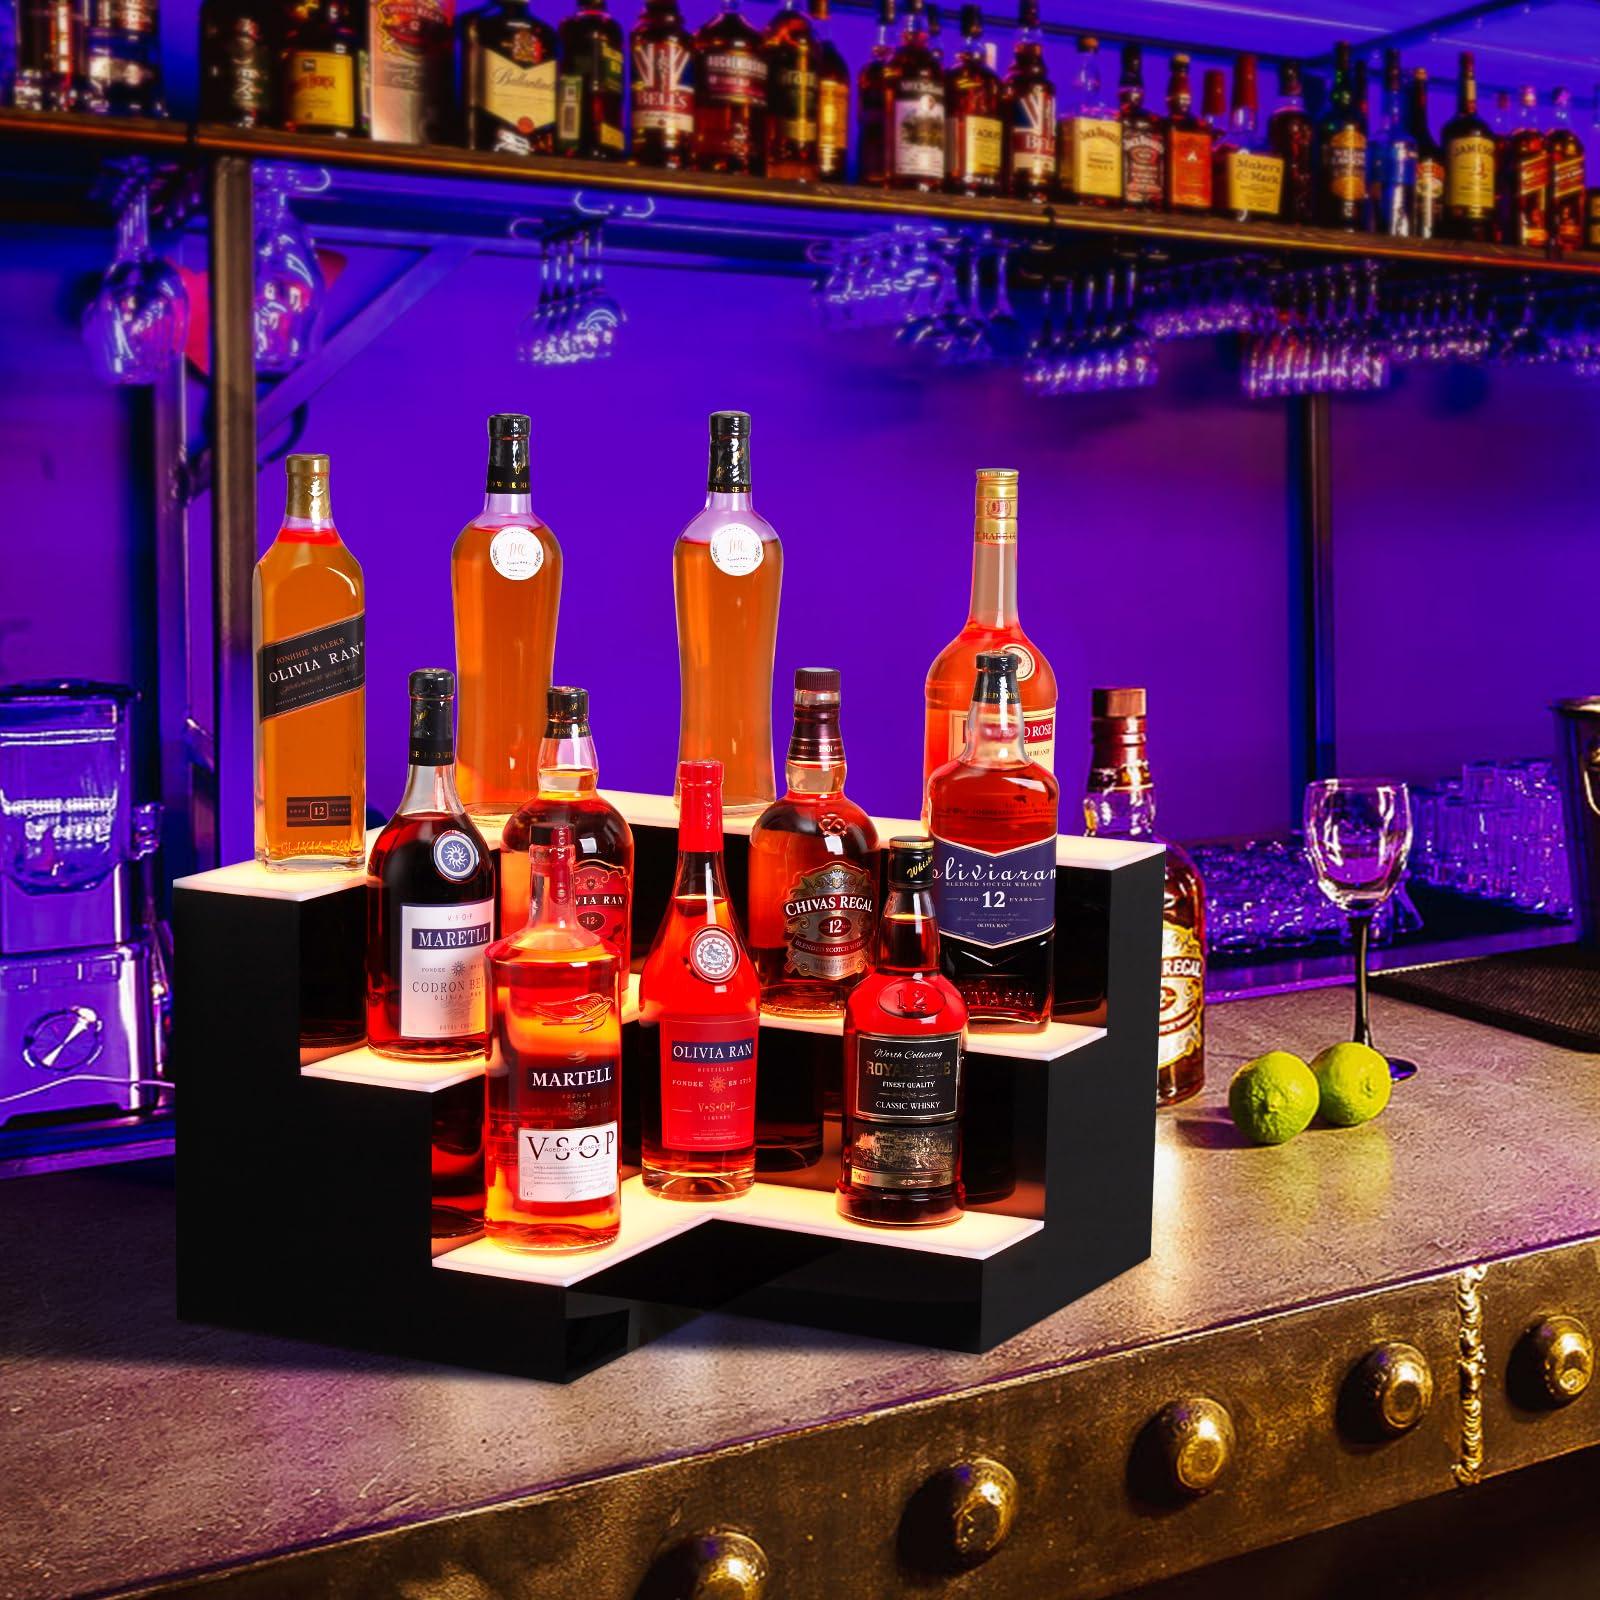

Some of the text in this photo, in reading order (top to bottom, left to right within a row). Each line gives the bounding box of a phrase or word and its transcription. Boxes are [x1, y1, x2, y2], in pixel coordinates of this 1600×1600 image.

[269, 659, 321, 683] OLIVIA
[1032, 723, 1053, 737] ROSE
[313, 806, 325, 816] 12
[575, 895, 624, 905] VIA RAN
[785, 895, 873, 917] CHIVAS REGAL
[982, 890, 1006, 908] 12
[829, 919, 842, 934] 12
[418, 927, 489, 948] MARETLL
[412, 980, 465, 993] CODRON
[673, 1043, 752, 1059] OLIVIA RAN
[874, 1048, 943, 1060] Worth Collecting
[532, 1066, 612, 1087] MARTELL
[882, 1080, 936, 1089] FINEST QUALITY
[875, 1101, 940, 1110] CLASSIC WHISKY
